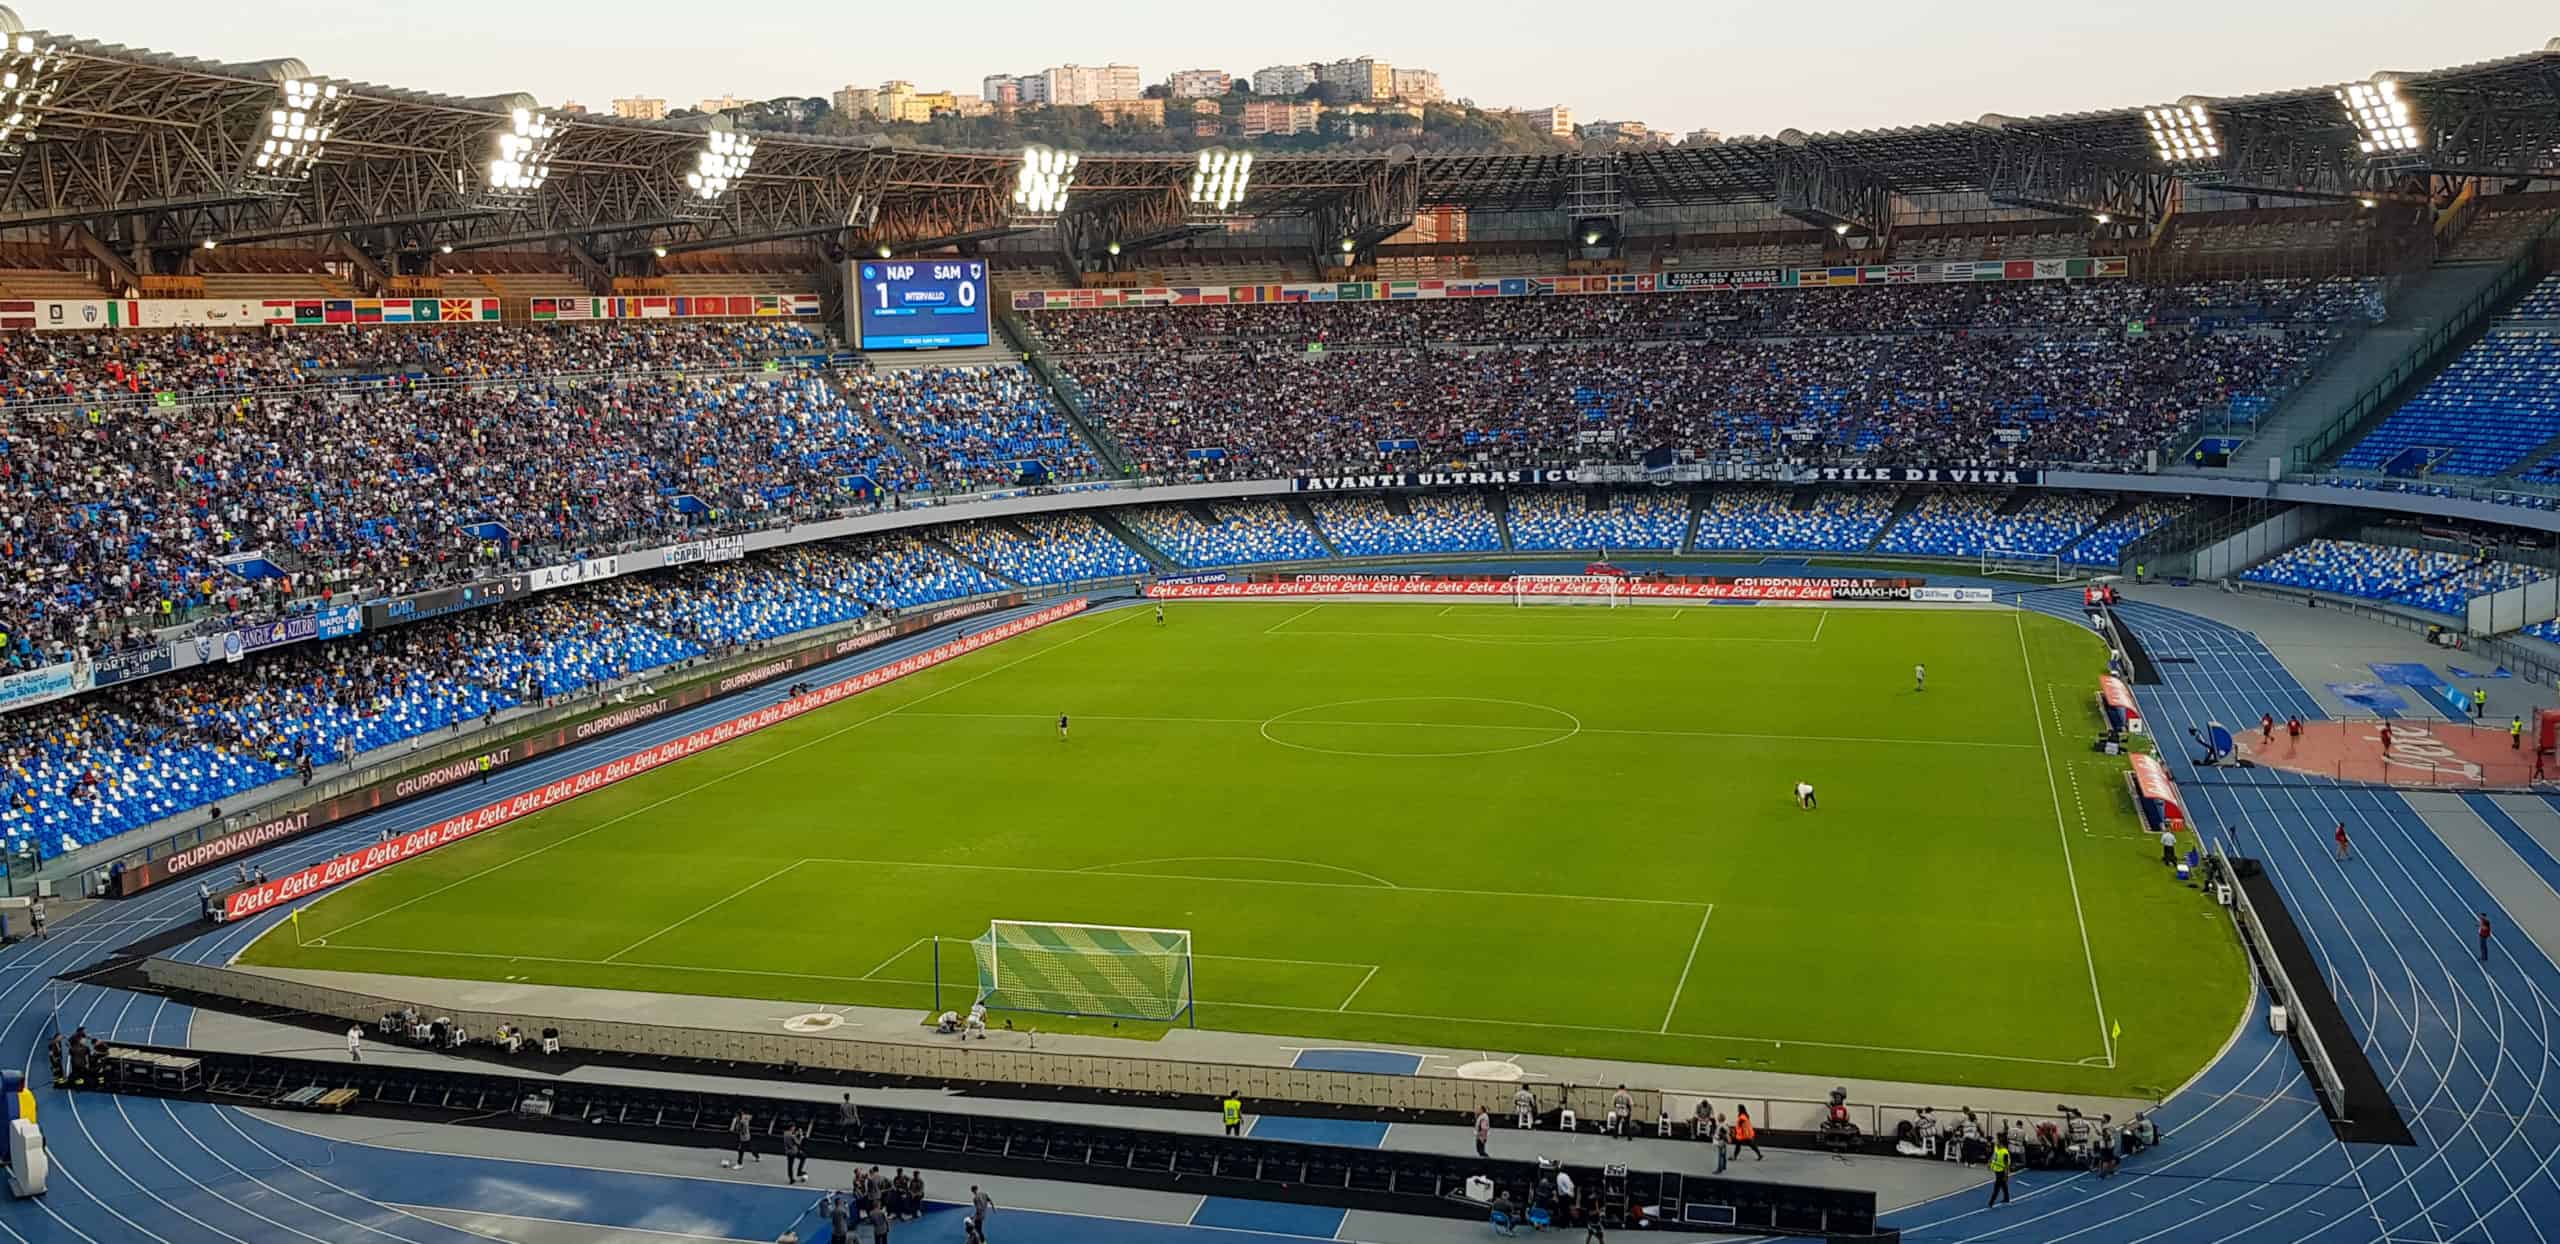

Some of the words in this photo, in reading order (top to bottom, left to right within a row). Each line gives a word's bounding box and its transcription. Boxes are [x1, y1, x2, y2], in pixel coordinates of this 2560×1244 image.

[887, 266, 915, 280] NAP
[934, 265, 961, 279] SAM
[876, 282, 889, 308] 1
[904, 291, 945, 301] INTERVALLO
[958, 281, 976, 306] 0
[1307, 473, 1406, 490] AVANTI
[1419, 470, 1520, 486] ULTRAS
[1906, 468, 1938, 481] DI
[1950, 470, 2019, 483] VITA
[705, 535, 744, 549] APULIA
[673, 545, 702, 562] CAPRI
[1197, 573, 1226, 584] TUFANO
[1296, 574, 1421, 582] GRUPPONAVARRAIT
[1734, 578, 1875, 587] GRUPPONAVARRAIT
[1148, 586, 1178, 597] Lete
[1181, 586, 1209, 596] Lete
[1212, 584, 1242, 595] Lete
[1244, 584, 1273, 594] Lete
[1276, 583, 1306, 594] Lete
[1308, 582, 1337, 593] Lete
[1338, 582, 1368, 592] Lete
[1370, 582, 1400, 592] Lete
[1400, 582, 1431, 592] Lete
[1432, 582, 1462, 592] Lete
[1464, 582, 1495, 593] Lete
[1530, 583, 1560, 593] Lete
[1561, 583, 1592, 594] Lete
[1626, 584, 1658, 594] Lete
[1661, 584, 1692, 596] Lete
[1695, 585, 1727, 596] Lete
[1728, 586, 1760, 597] Lete
[1761, 587, 1796, 598] Lete
[1796, 587, 1831, 598] Lete
[1833, 587, 1910, 598] HAMAKI-HO
[319, 615, 347, 627] NAPOLI
[240, 626, 272, 648] SANGUE
[328, 625, 344, 636] FAN
[721, 658, 793, 691] GRUPPONAVARRA.IT
[577, 698, 668, 739] GRUPPONAVARRA.IT
[229, 888, 273, 914] Lete
[276, 871, 317, 897] Lete
[320, 856, 359, 881] Lete
[361, 842, 399, 866] Lete
[400, 829, 436, 851] Lete
[439, 816, 472, 838] Lete
[475, 804, 507, 825] Lete
[509, 792, 540, 813] Lete
[542, 781, 571, 801] Lete
[574, 770, 601, 790] Lete
[603, 760, 630, 779] Lete
[631, 750, 657, 769] Lete
[659, 741, 683, 759] Lete
[686, 732, 709, 750] Lete
[710, 723, 733, 741] Lete
[734, 715, 756, 732] Lete
[167, 811, 310, 874] GRUPPONAVARRA.IT
